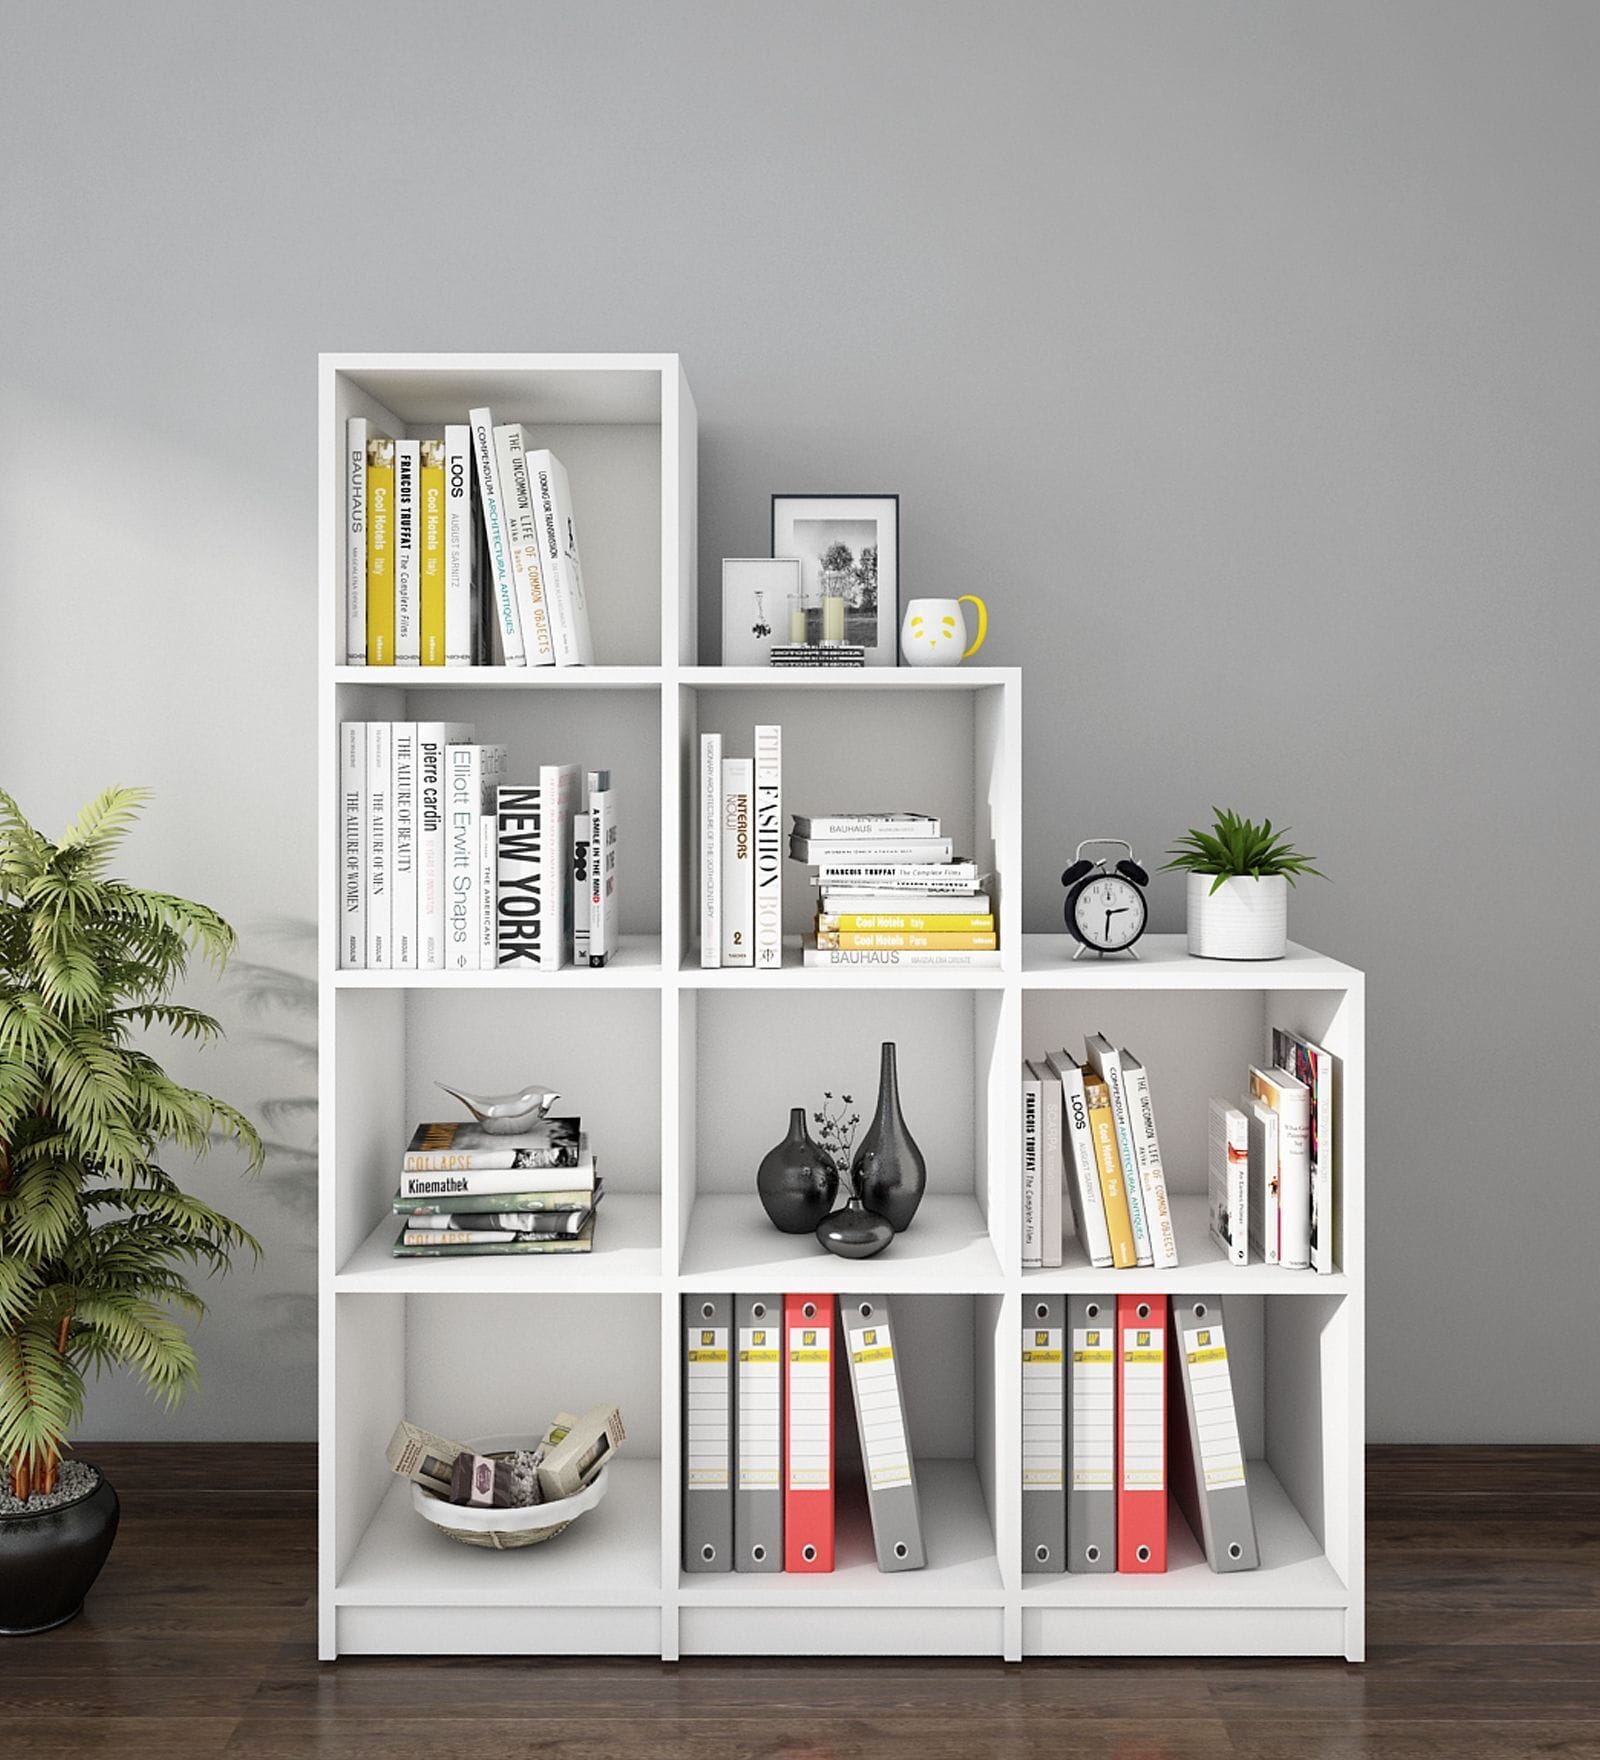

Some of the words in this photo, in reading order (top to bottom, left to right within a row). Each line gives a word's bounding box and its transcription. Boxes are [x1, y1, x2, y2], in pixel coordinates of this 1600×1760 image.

[508, 434, 520, 452] THE
[352, 450, 363, 533] BAUHAUS
[400, 455, 412, 504] FRANCOIS
[451, 455, 464, 498] LOOS
[511, 458, 529, 509] UNCOMMON
[538, 471, 552, 500] LOOKING
[374, 488, 386, 513] Cool
[427, 488, 439, 513] Cool
[374, 515, 386, 550] Hotels
[400, 507, 412, 550] TRUFFAT
[427, 516, 439, 551] Hotels
[451, 513, 460, 548] AUGUST
[477, 426, 495, 495] COMPENDIUM
[487, 498, 507, 581] ARCHITECTURAL
[500, 583, 515, 635] ANTIQUES
[519, 515, 534, 540] LIFE
[372, 558, 386, 575] Italy
[400, 554, 410, 571] The
[425, 558, 438, 576] Italy
[451, 551, 460, 588] SARNITZ
[524, 546, 536, 558] OF
[398, 572, 410, 613] Complete
[527, 565, 543, 603] COMMON
[399, 615, 410, 638] Films
[534, 609, 549, 654] OBJECTS
[398, 736, 411, 760] THE
[421, 743, 442, 783] pierre
[706, 741, 714, 776] VISIONARY
[758, 729, 778, 778] THE
[398, 762, 411, 807] ALLURE
[453, 751, 471, 804] Elliott
[347, 791, 359, 813] THE
[373, 791, 384, 812] THE
[398, 809, 411, 825] OF
[423, 788, 442, 832] cardin
[706, 776, 714, 829] ARCHITECTURE
[347, 814, 359, 854] ALLURE
[373, 814, 384, 854] ALLURE
[453, 812, 471, 868] Erwitt
[499, 789, 541, 863] NEW
[592, 817, 600, 845] SMILE
[706, 831, 714, 841] OF
[737, 794, 748, 859] INTERIORS
[758, 785, 778, 887] FASHION
[829, 824, 872, 834] BAUHAUS
[347, 856, 359, 870] OF
[373, 856, 384, 870] OF
[398, 827, 411, 874] BEAUTY
[592, 847, 600, 857] IN
[706, 842, 714, 856] THE
[373, 872, 384, 895] MEN
[592, 859, 600, 876] THE
[347, 871, 359, 913] WOMEN
[450, 876, 471, 943] Snaps
[706, 880, 714, 918] CENTURY
[499, 873, 541, 965] YORK
[856, 917, 875, 928] Cool
[877, 917, 905, 928] Hotels
[733, 932, 742, 946] 2
[854, 935, 873, 946] Cool
[876, 935, 904, 946] Hotels
[830, 951, 900, 964] BAUHAUS
[1136, 1076, 1147, 1092] THE
[1026, 1092, 1036, 1134] FRANCOIS
[1047, 1103, 1058, 1153] SCARPA
[1071, 1094, 1086, 1130] LOOS
[1139, 1096, 1155, 1139] UNCOMMON
[1099, 1123, 1110, 1143] Cool
[1026, 1137, 1036, 1171] TRUFFAT
[1102, 1144, 1116, 1174] Hotels
[1147, 1144, 1159, 1165] LIFE
[408, 1177, 469, 1194] Kinemathek
[1119, 1126, 1137, 1194] ARCHITECTURAL
[1131, 1197, 1144, 1240] ANTIQUES
[1152, 1169, 1161, 1180] OF
[1154, 1184, 1167, 1217] COMMON
[1160, 1221, 1175, 1258] OBJECTS
